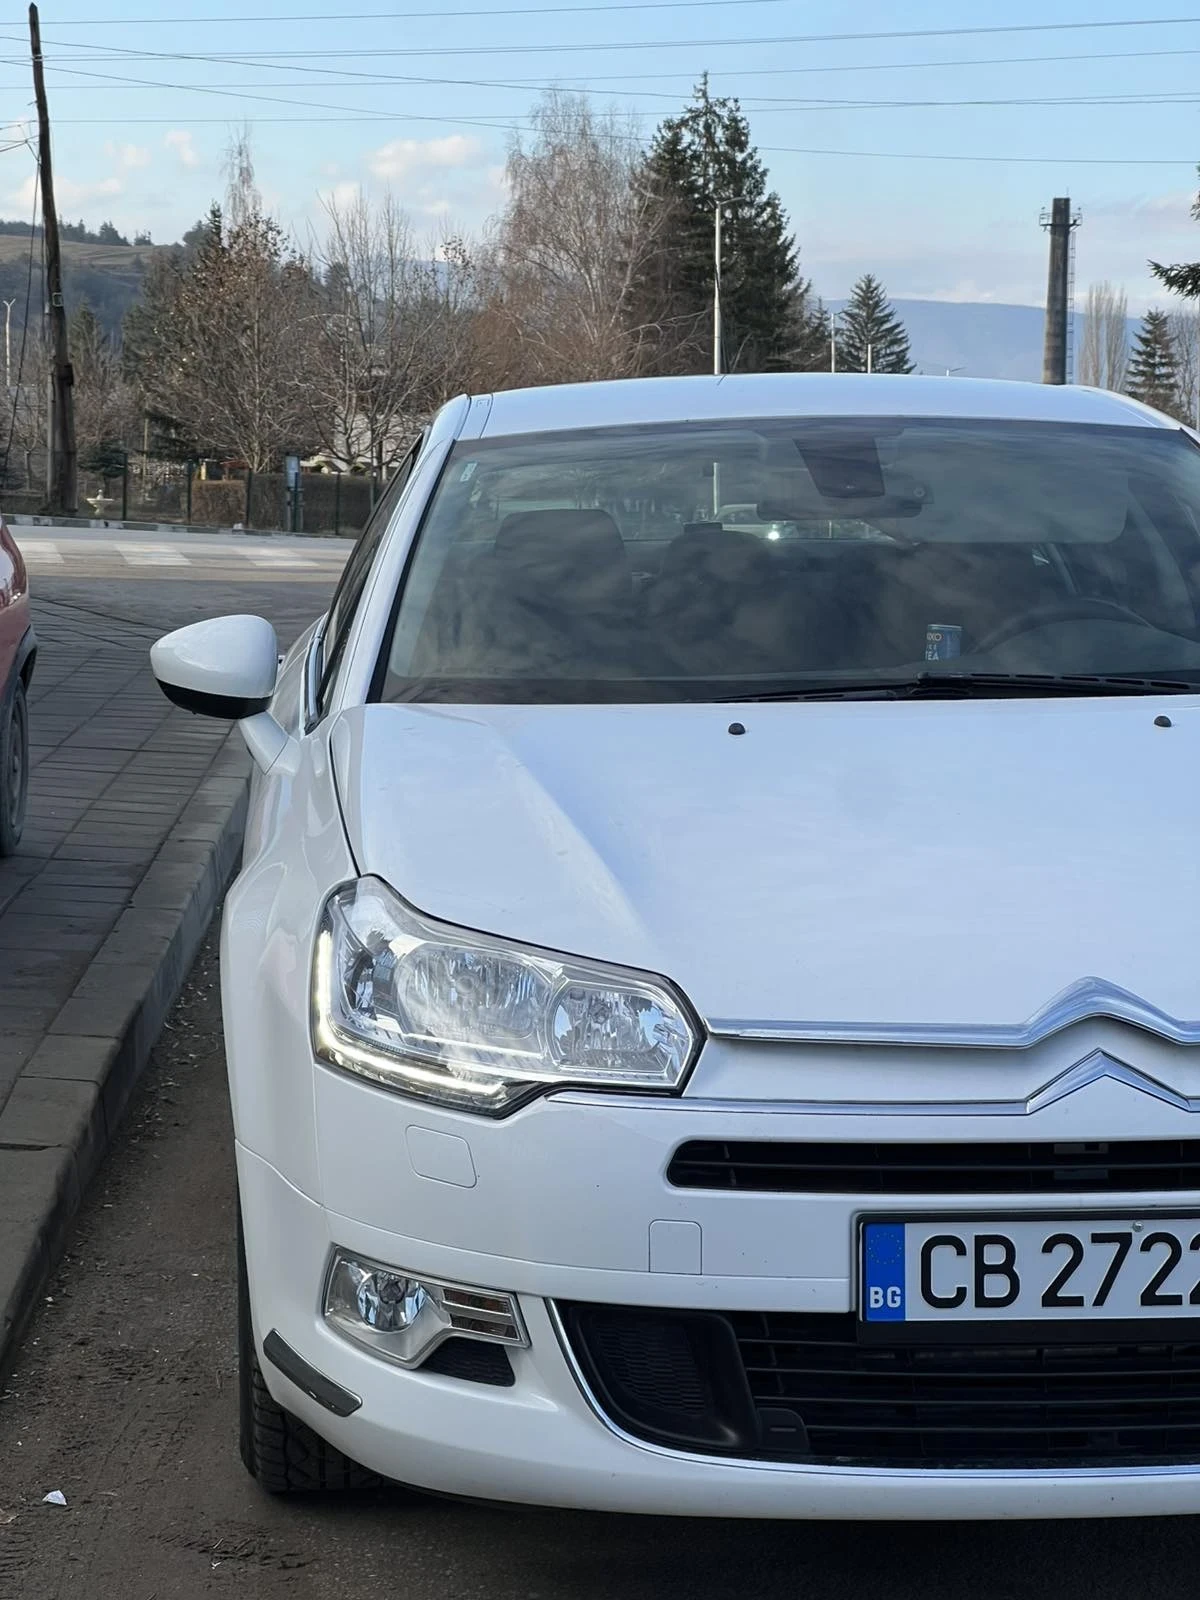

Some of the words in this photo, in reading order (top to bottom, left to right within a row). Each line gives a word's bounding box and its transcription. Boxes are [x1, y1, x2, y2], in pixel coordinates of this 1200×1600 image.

[921, 1234, 1021, 1309] CB
[1041, 1232, 1200, 1307] 272
[869, 1286, 902, 1309] BG
